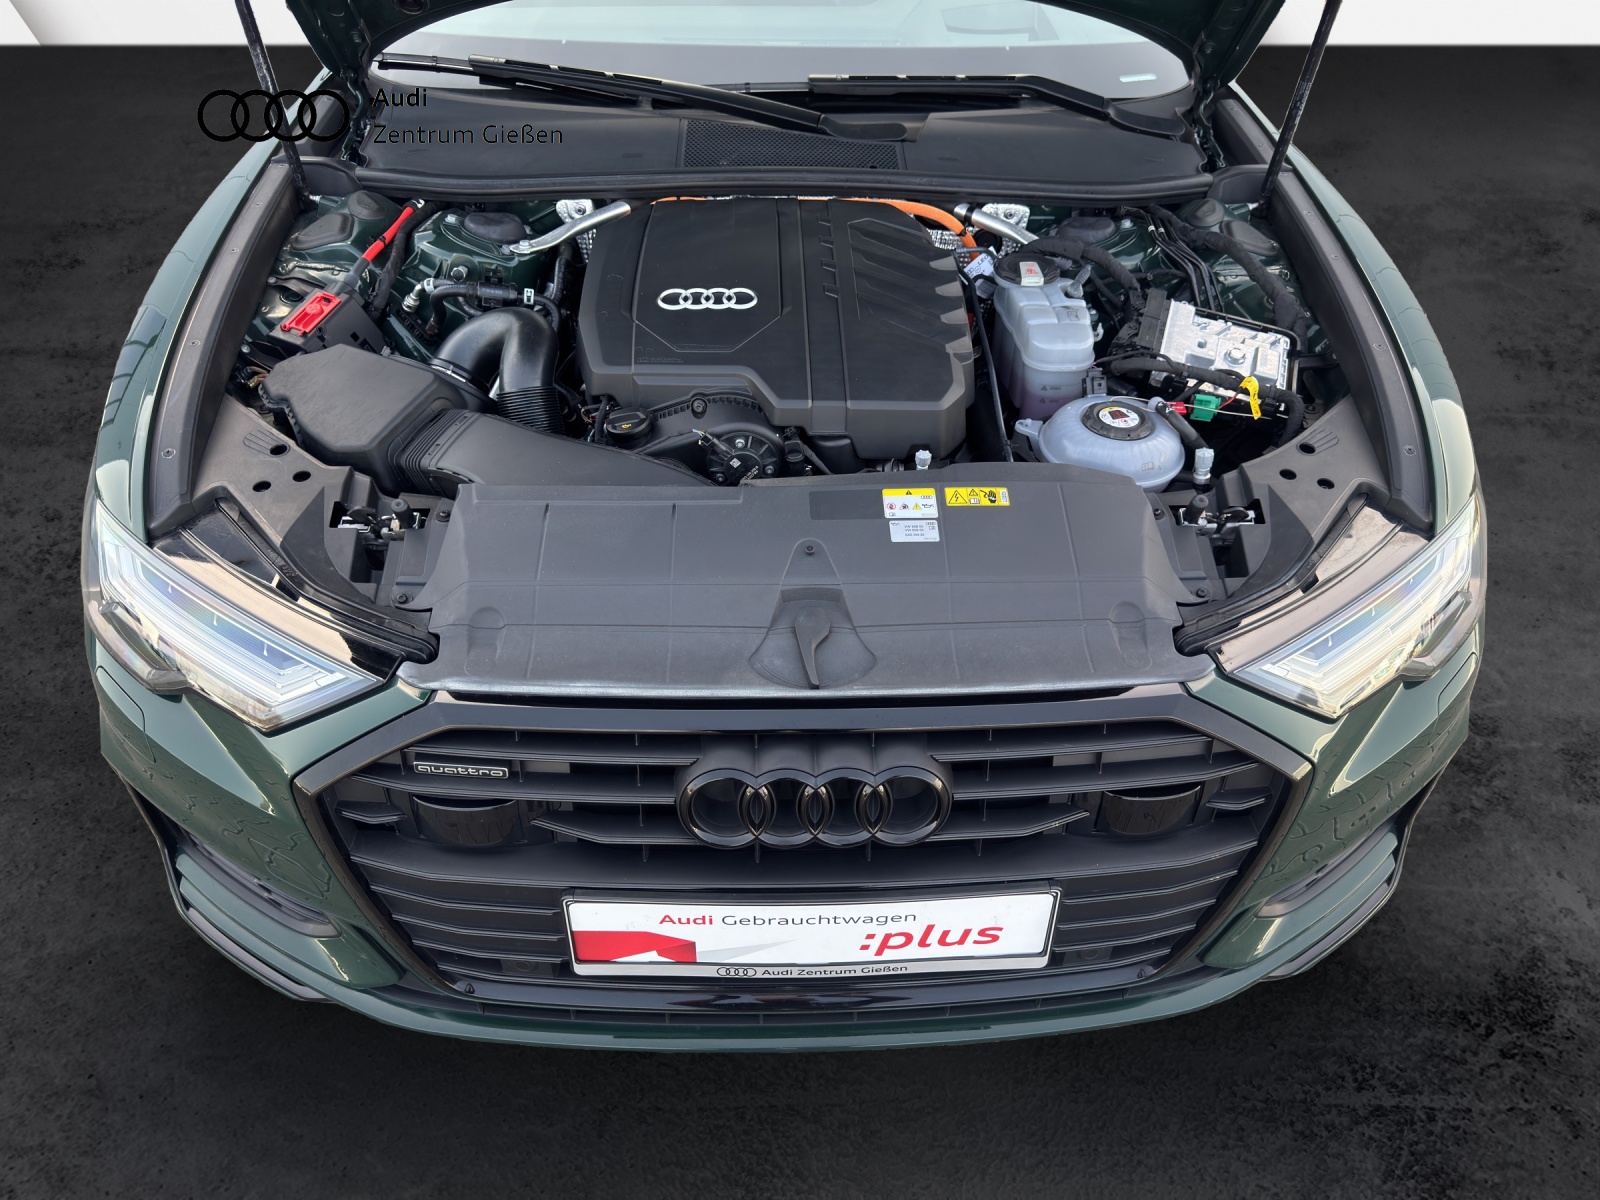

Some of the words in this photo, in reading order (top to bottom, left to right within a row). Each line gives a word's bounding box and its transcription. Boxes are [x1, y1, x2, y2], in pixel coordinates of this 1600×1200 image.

[417, 765, 503, 777] quattro
[658, 914, 714, 926] Audi
[721, 912, 917, 926] Gebrauchtwagen
[761, 968, 793, 976] Audi
[797, 967, 857, 976] Zentrum
[861, 965, 908, 975] Gießen
